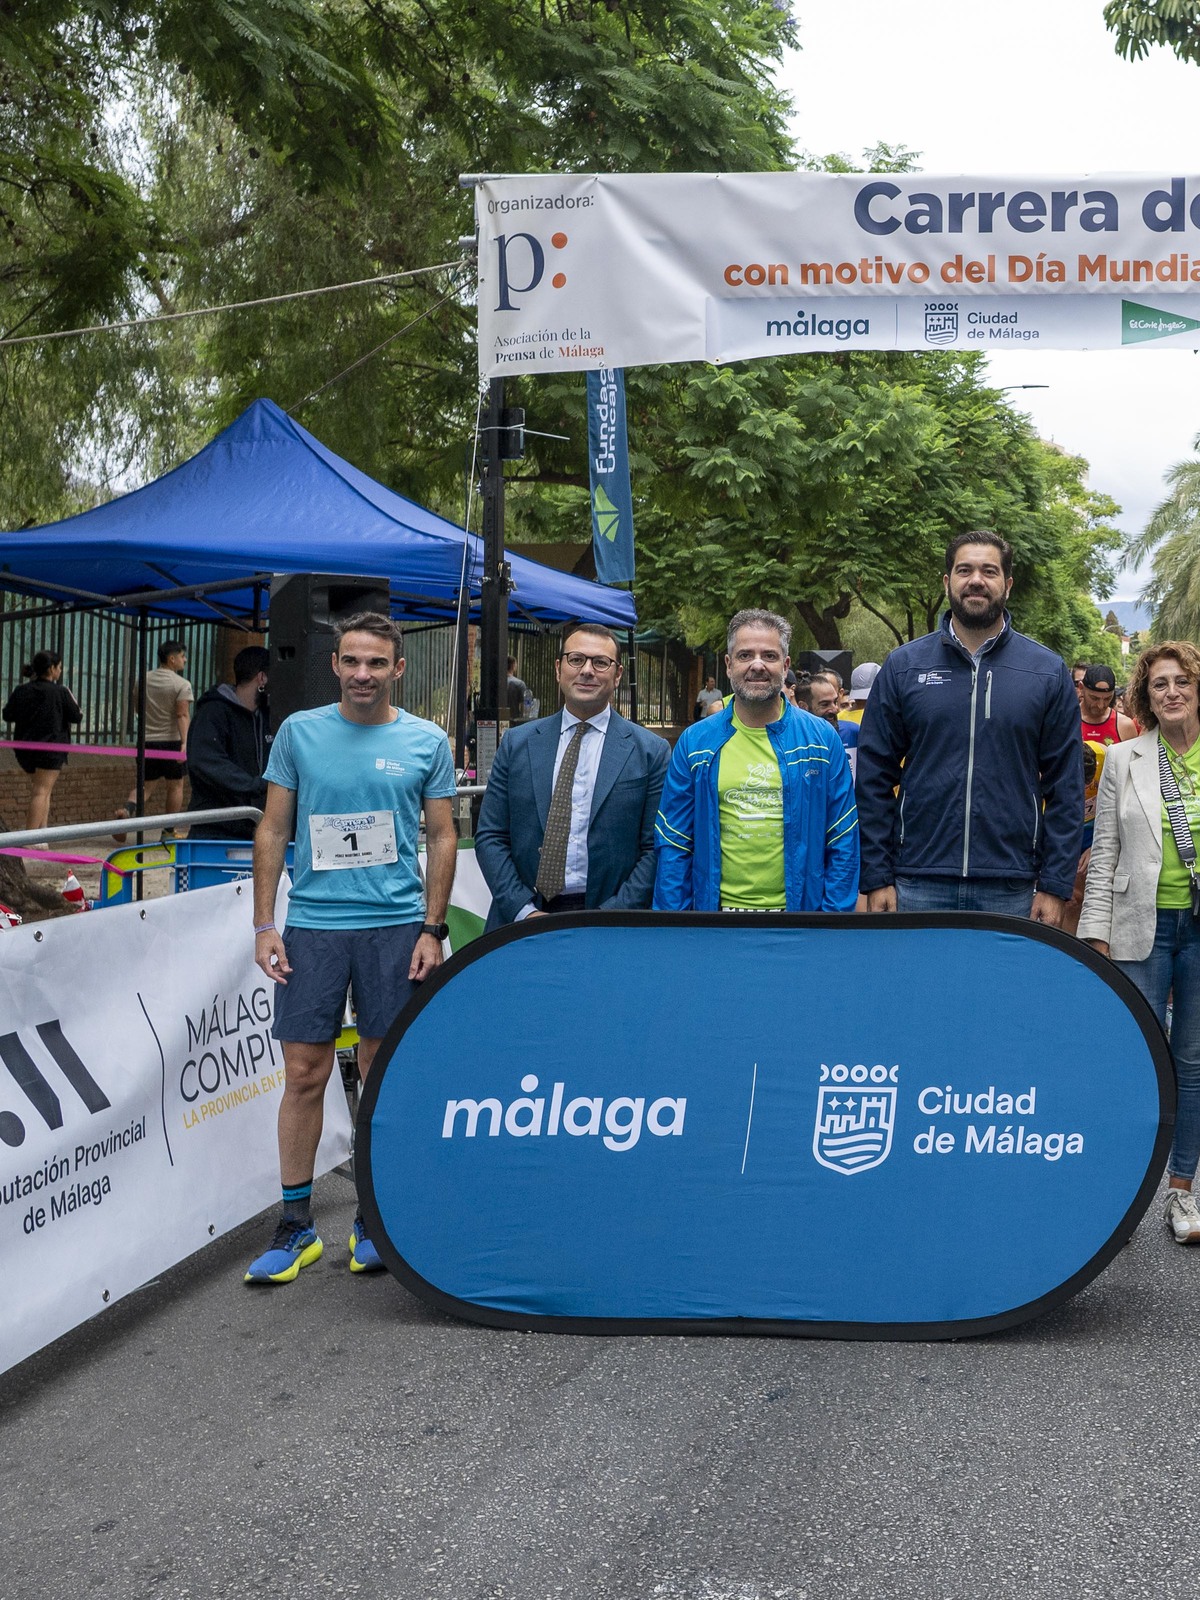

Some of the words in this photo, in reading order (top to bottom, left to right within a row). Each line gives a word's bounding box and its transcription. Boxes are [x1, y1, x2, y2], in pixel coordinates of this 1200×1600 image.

[487, 194, 594, 215] Organizadora:
[854, 180, 1119, 236] Carrera
[723, 264, 789, 287] con
[800, 256, 931, 286] motivo
[940, 254, 996, 284] del
[1008, 253, 1066, 283] Día
[967, 311, 1018, 325] Ciudad
[967, 327, 985, 340] de
[988, 326, 1040, 342] Málaga
[494, 329, 558, 348] Asociación
[561, 328, 578, 341] de
[580, 327, 591, 340] la
[495, 350, 536, 364] Prensa
[539, 347, 555, 360] de
[558, 344, 605, 360] Málaga
[595, 369, 608, 474] Fundac
[342, 832, 359, 851] 1
[185, 987, 272, 1053] MÁLAG
[180, 1028, 281, 1103] COMPI
[183, 1109, 200, 1129] LA
[200, 1081, 261, 1121] PROVINCIA
[260, 1073, 277, 1094] EN
[917, 1086, 1037, 1116] Ciudad
[0, 1154, 70, 1205] utación
[74, 1115, 146, 1172] Provincial
[913, 1125, 956, 1156] de
[965, 1125, 1084, 1162] Málaga
[23, 1205, 46, 1235] de
[50, 1174, 112, 1221] Málaga
